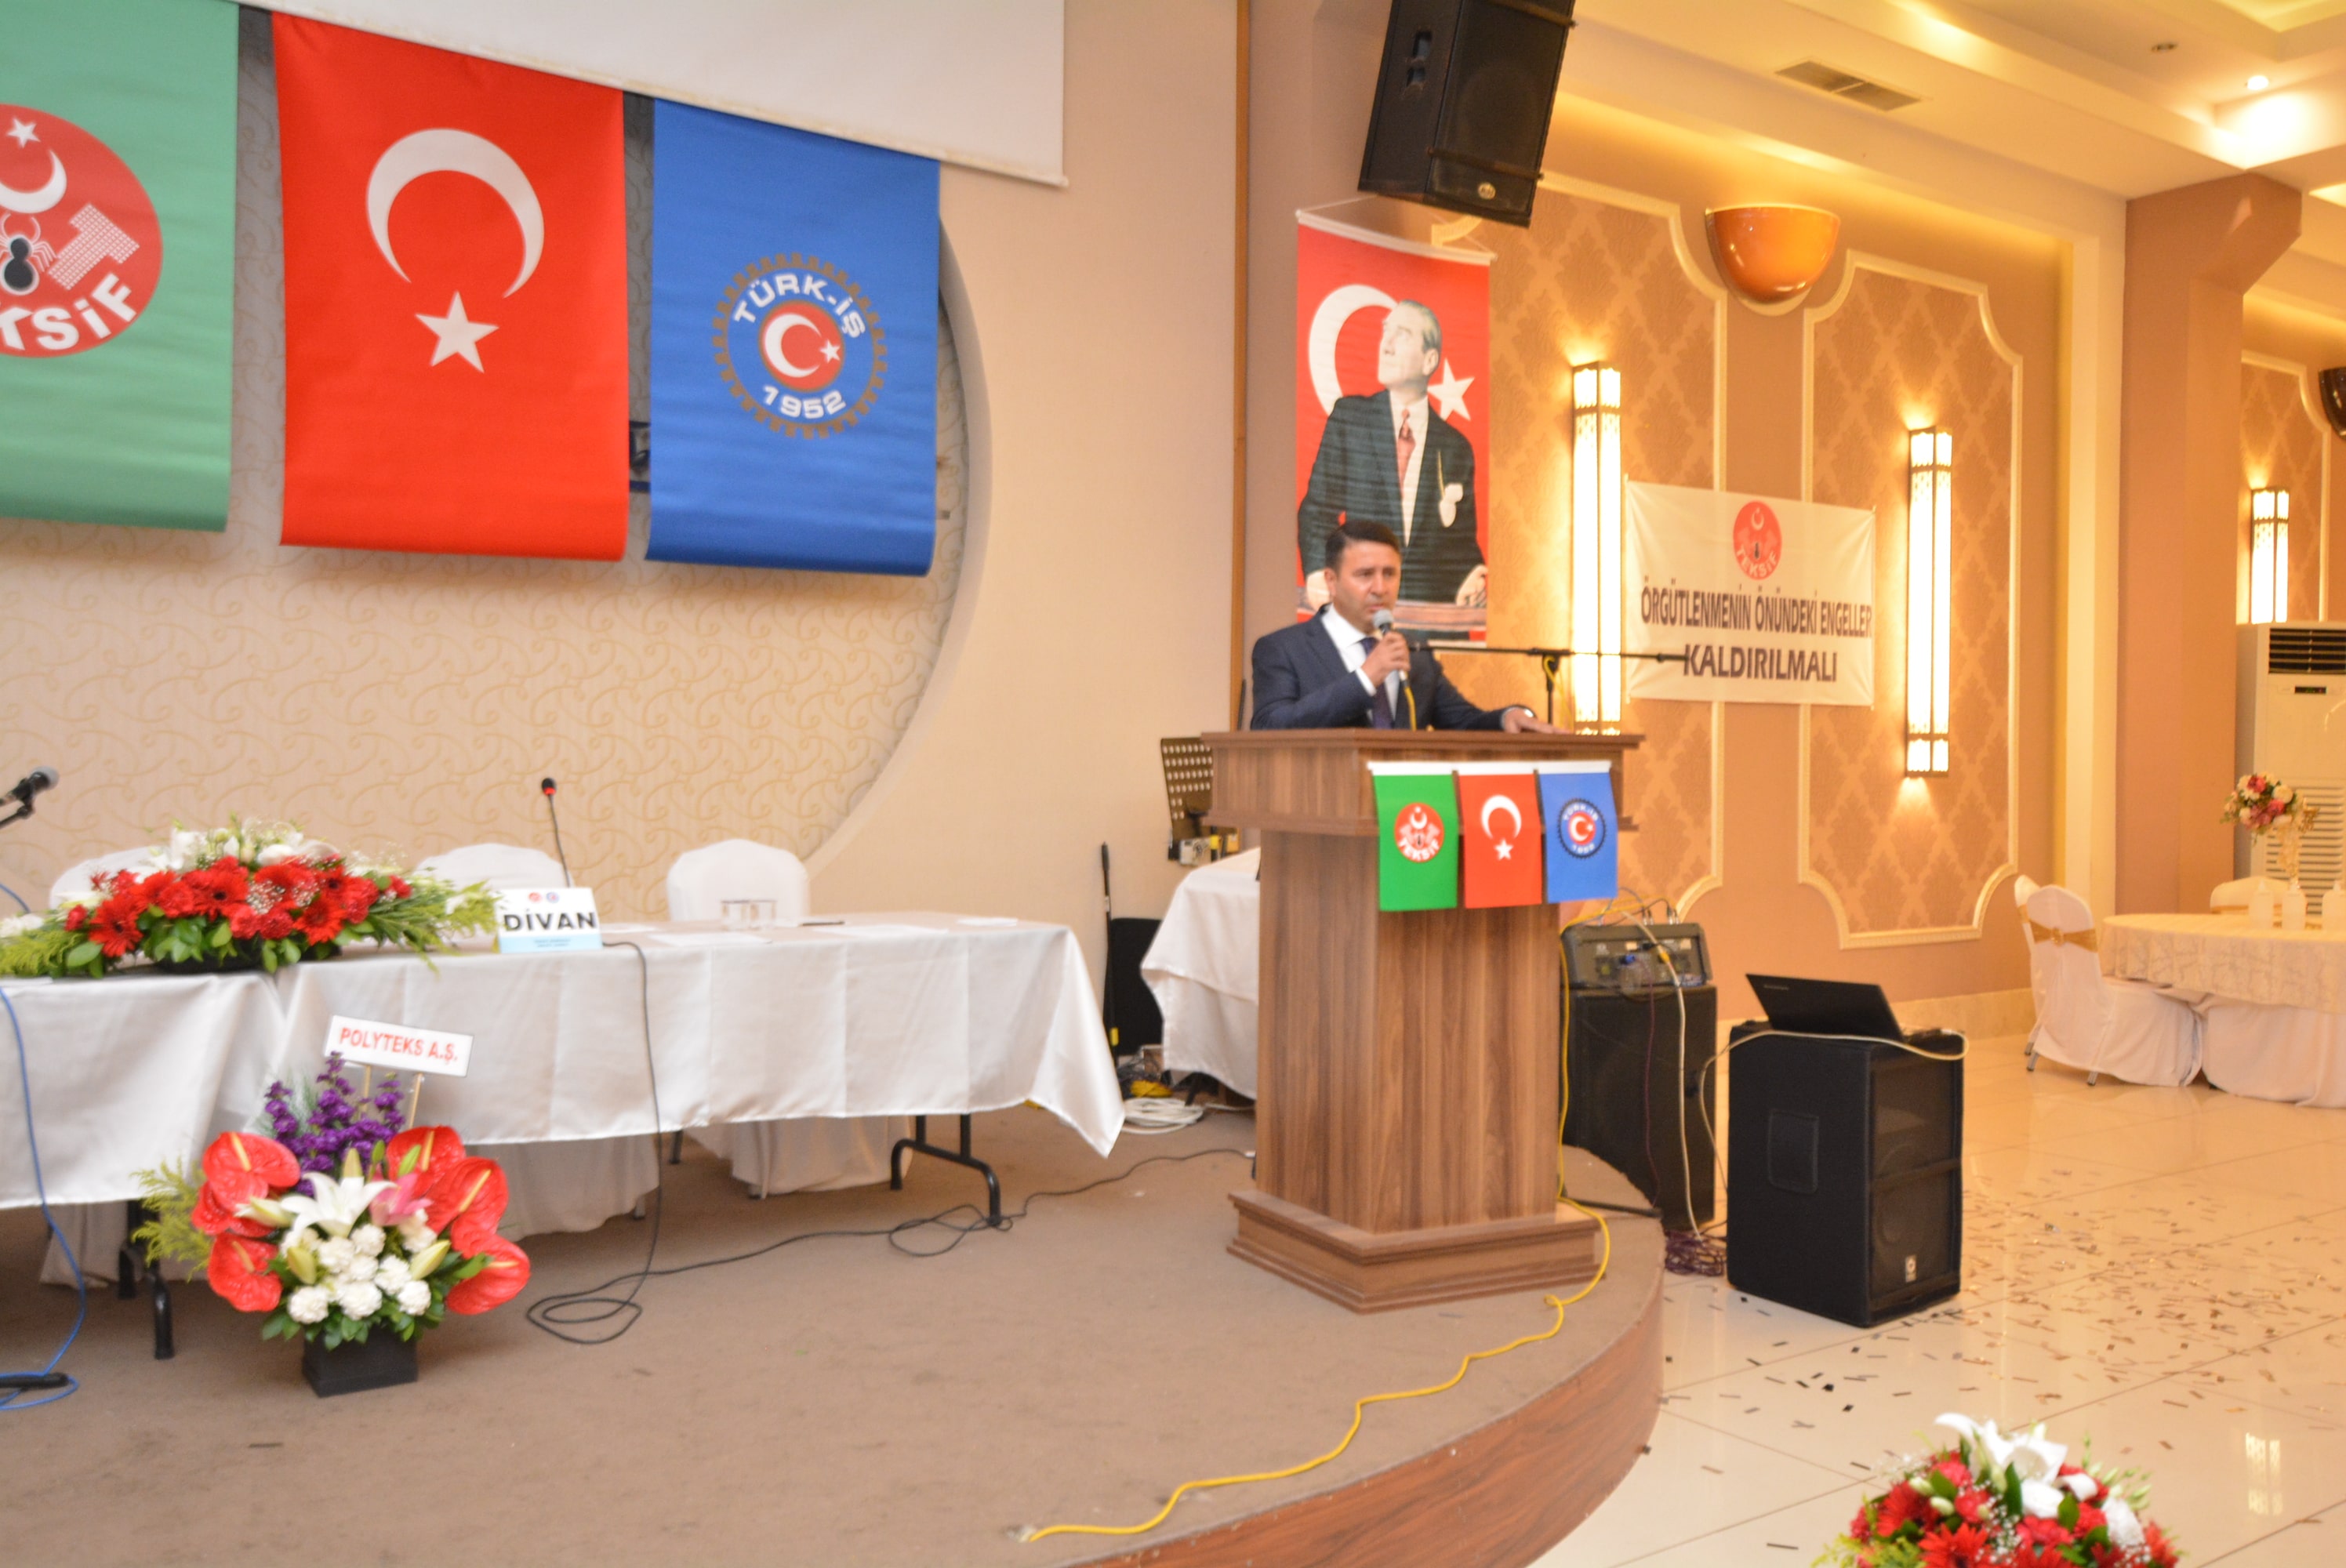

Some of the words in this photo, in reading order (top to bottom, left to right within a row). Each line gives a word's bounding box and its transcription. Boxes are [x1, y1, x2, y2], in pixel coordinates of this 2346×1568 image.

[734, 274, 866, 338] TÜRK-İŞ
[763, 385, 846, 419] 1952
[1640, 575, 1751, 631] ÖRGÜTLENMENİN
[1755, 585, 1817, 634] ÖNÜNDEKİ
[1683, 643, 1838, 682] KALDIRILMALI
[503, 908, 597, 932] DİVAN
[340, 1027, 423, 1057] POLYTEKS
